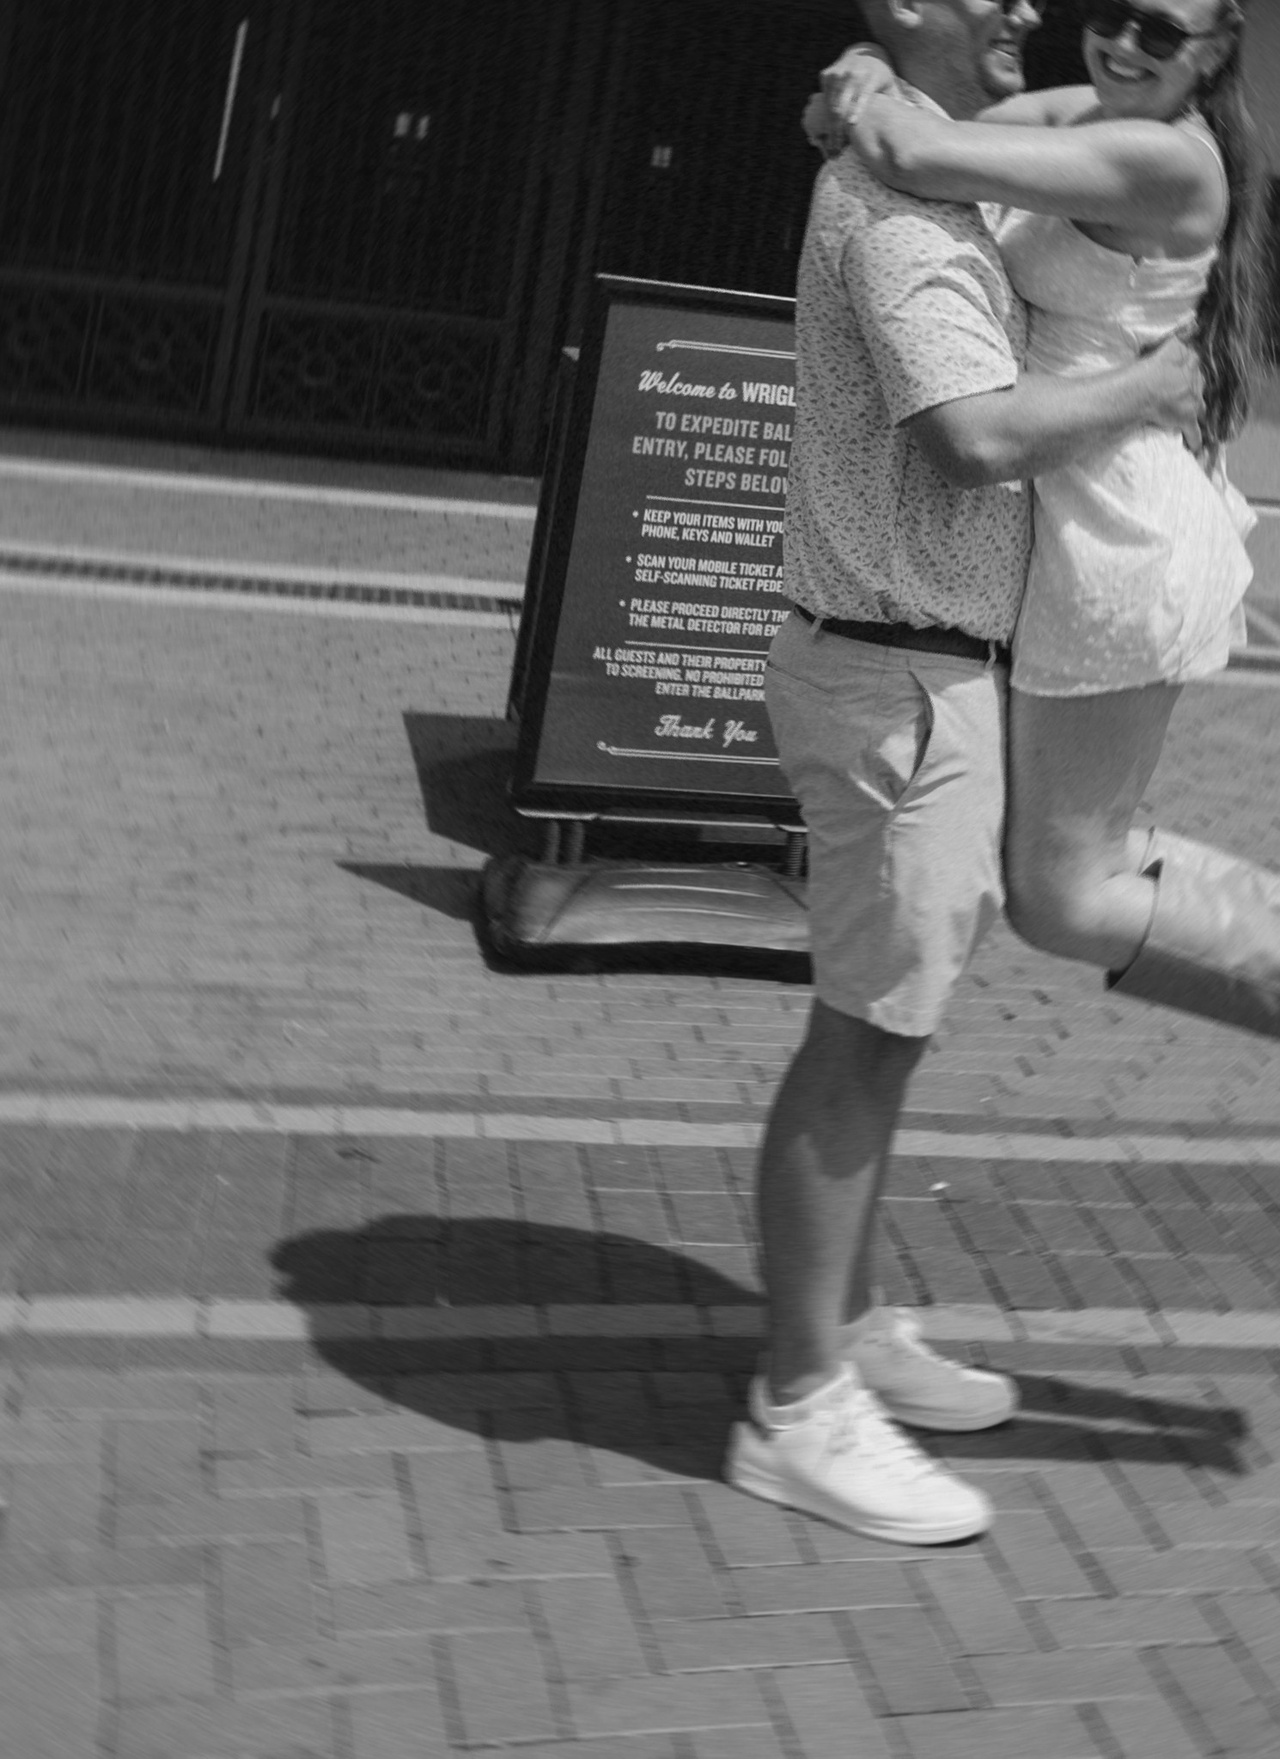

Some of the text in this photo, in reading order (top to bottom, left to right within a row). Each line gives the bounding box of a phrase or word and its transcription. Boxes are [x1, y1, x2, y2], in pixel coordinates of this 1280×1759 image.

[638, 369, 797, 407] Welcome to WRIGL
[655, 411, 793, 442] TO EXPEDITE BAL
[632, 435, 788, 468] ENTRY, PLEASE FOL
[684, 467, 737, 490] STEPS
[643, 508, 671, 525] KEEP
[672, 511, 701, 527] YOUR
[702, 514, 735, 530] ITEMS
[736, 517, 764, 532] WITH
[641, 523, 775, 548] PHONE, KEYS AND WALLET
[636, 552, 784, 579] SCAN YOUR MOBILE TICKET A
[635, 568, 717, 589] SELF-SCANNING
[719, 576, 756, 591] TICKET
[630, 597, 671, 615] PLEASE
[671, 601, 720, 618] PROCEED
[721, 606, 771, 622] DIRECTLY
[629, 612, 649, 627] THE
[650, 615, 685, 631] METAL
[687, 618, 741, 635] DETECTOR
[742, 622, 763, 637] FOR
[592, 646, 767, 672] ALL GUESTS AND THEIR PROPERTY
[605, 662, 620, 677] TO
[685, 669, 701, 683] NO
[701, 670, 765, 687] PROHIBITED
[655, 681, 690, 697] ENTER
[691, 684, 712, 699] THE
[654, 714, 759, 748] Thank You
